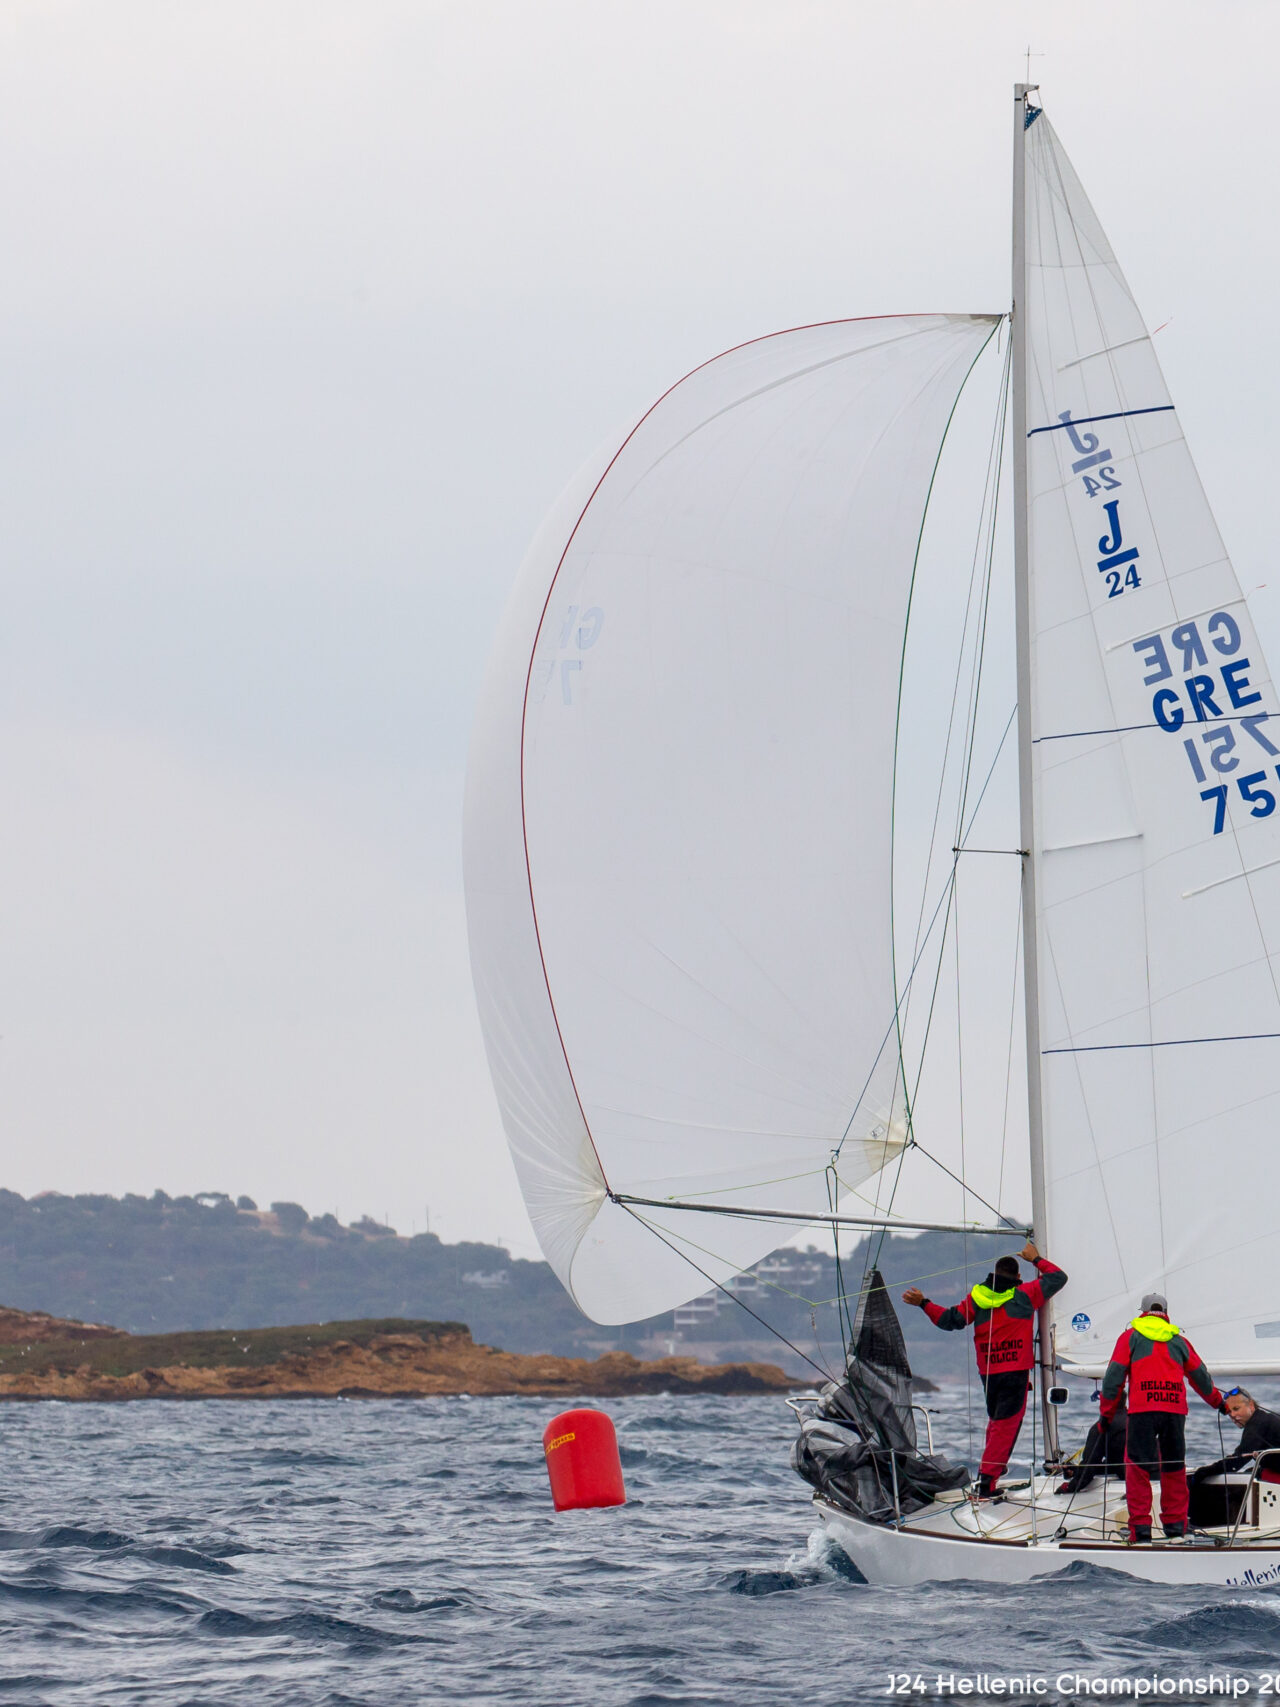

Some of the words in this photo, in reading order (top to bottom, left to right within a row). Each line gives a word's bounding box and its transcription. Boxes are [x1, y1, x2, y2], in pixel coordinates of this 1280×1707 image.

[1098, 499, 1123, 555] J
[1105, 564, 1142, 599] 24
[1152, 657, 1262, 733] GRE
[1146, 1391, 1180, 1404] POLICE
